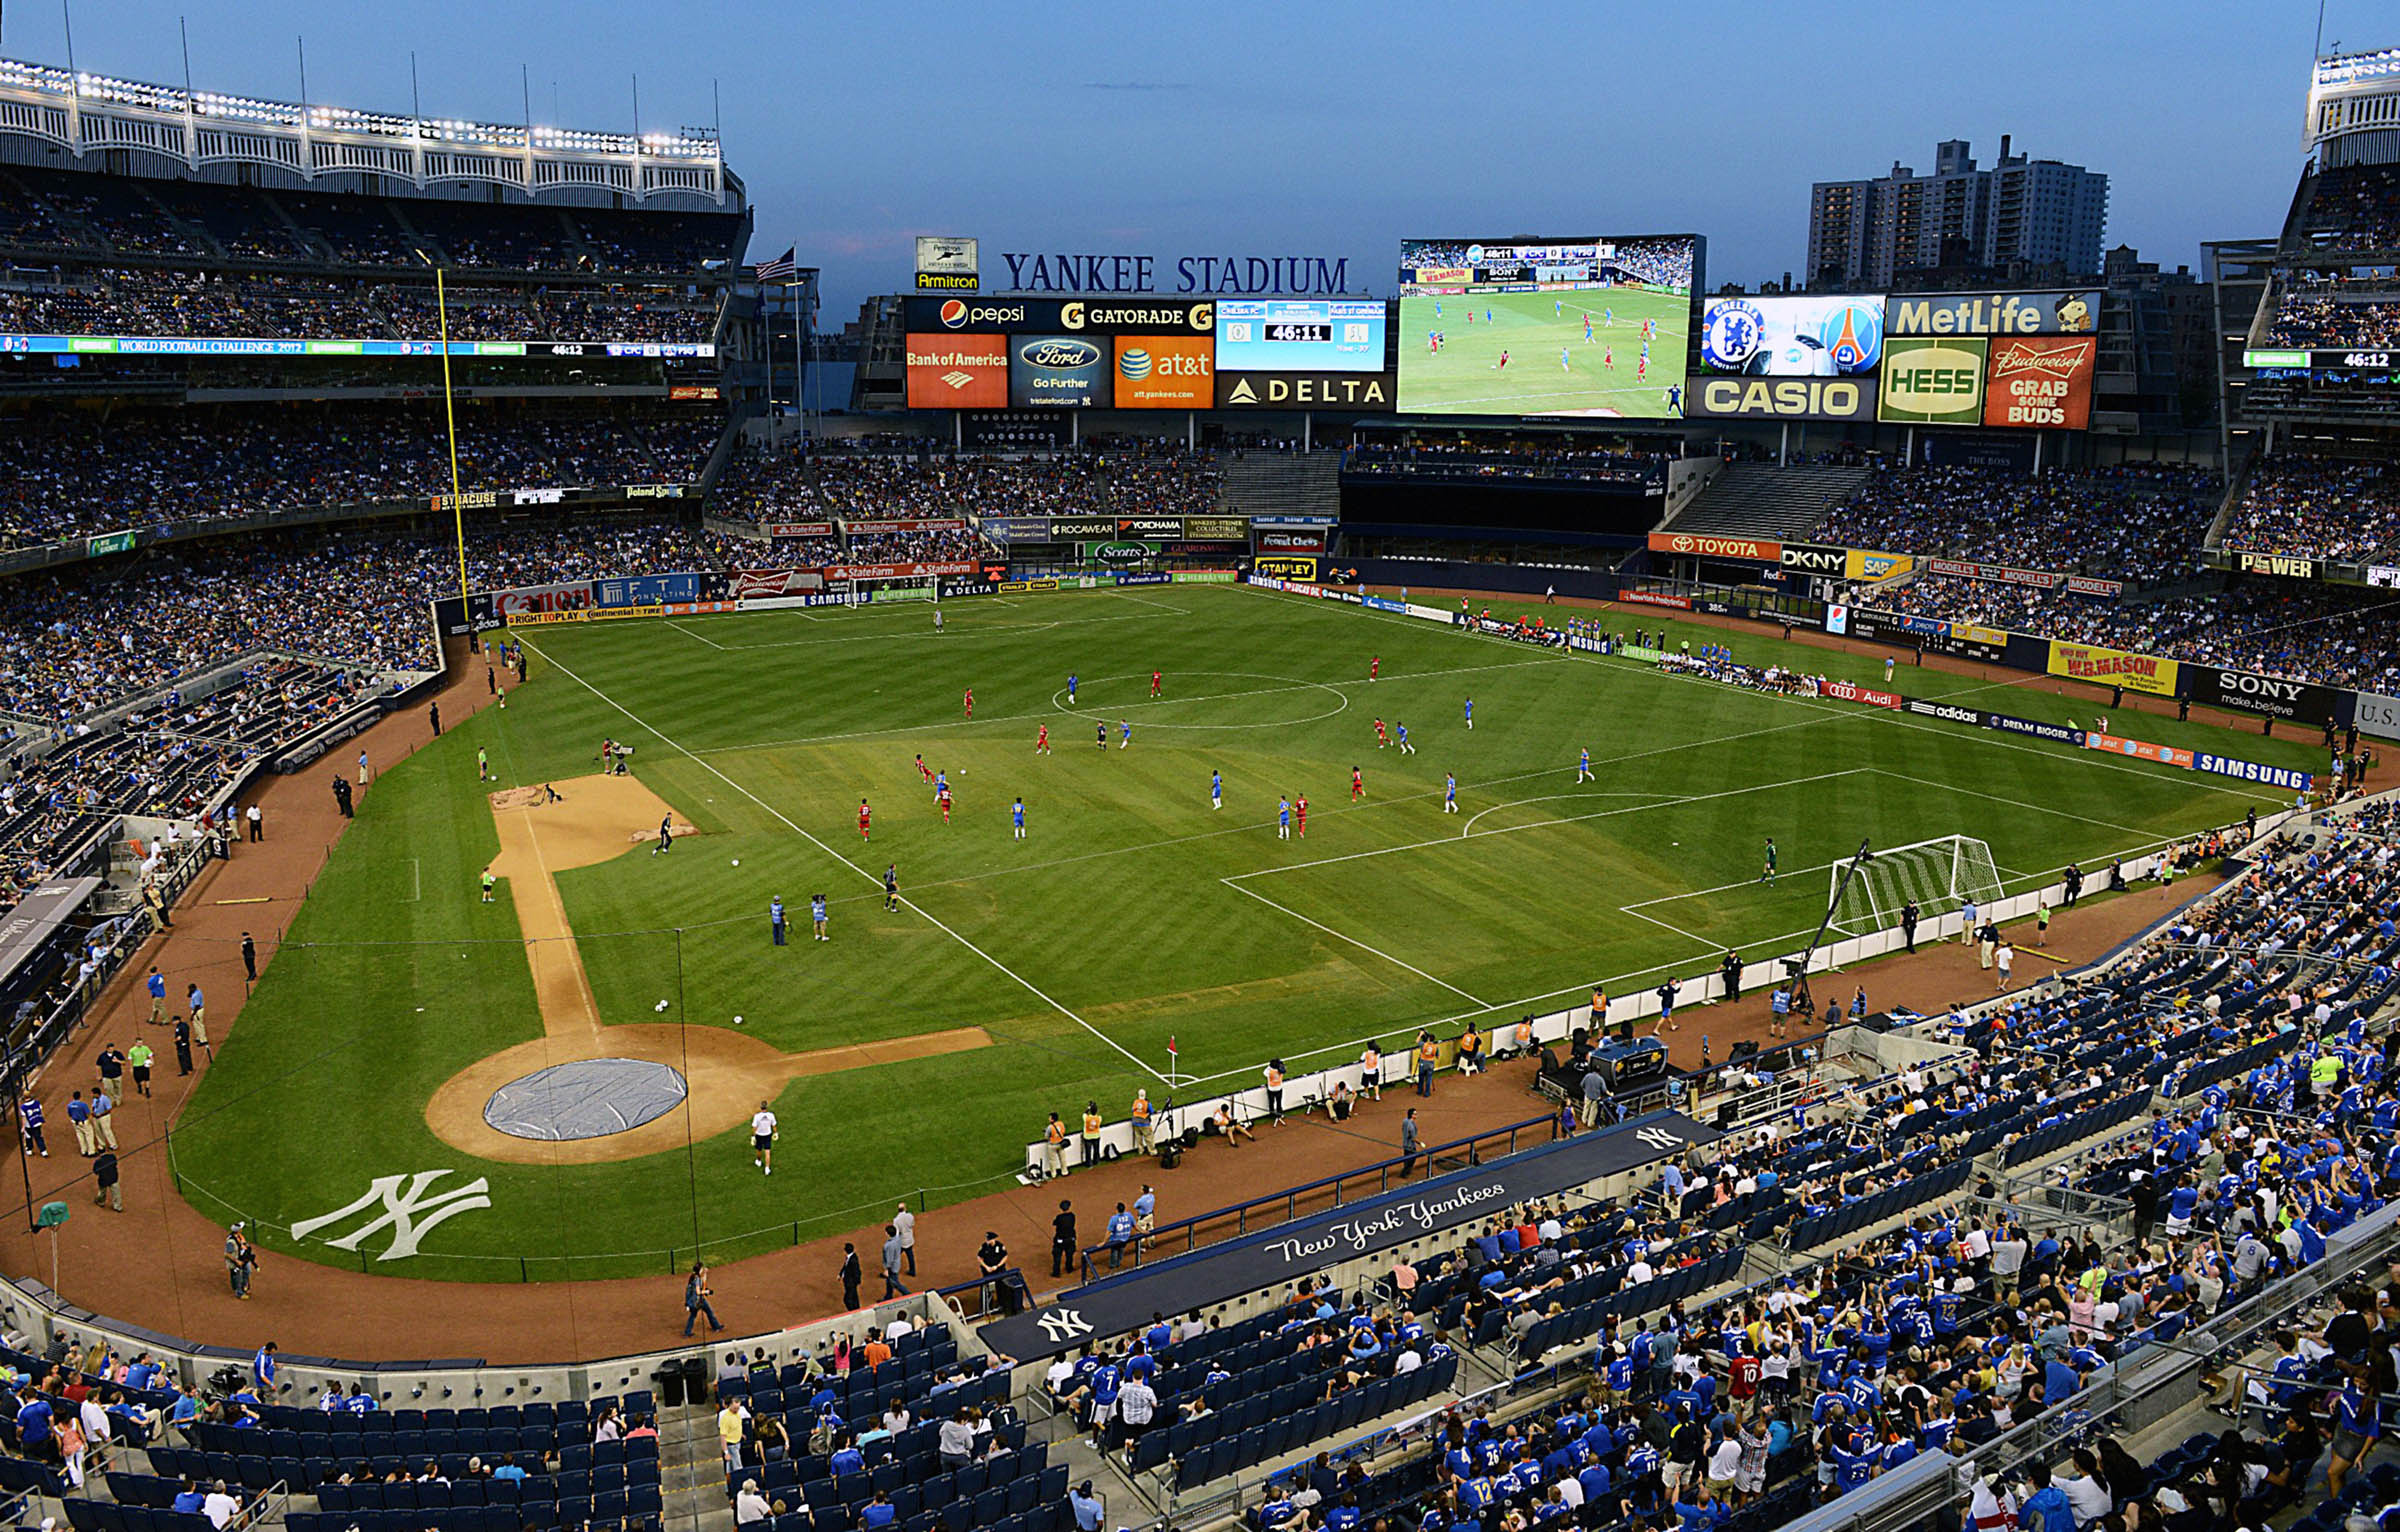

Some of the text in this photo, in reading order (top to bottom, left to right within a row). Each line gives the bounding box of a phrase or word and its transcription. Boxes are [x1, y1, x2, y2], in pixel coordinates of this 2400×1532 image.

[918, 273, 978, 289] Armitron
[1002, 253, 1349, 295] YANKEE STADIUM
[970, 305, 1025, 325] pepsi
[1090, 309, 1184, 325] GATORADE
[1713, 299, 1759, 319] CHELSEA
[1896, 295, 2042, 333] MetLife
[1272, 325, 1323, 341] 46:11
[120, 339, 159, 351] WORLD
[159, 341, 210, 352] FOOTBALL
[211, 342, 274, 353] CHALLENGE
[278, 343, 302, 353] 2012
[552, 344, 584, 356] 46:12
[1036, 342, 1085, 366] Ford
[906, 352, 1008, 367] Bank of America
[1158, 353, 1210, 376] at&t
[1995, 349, 2084, 370] Budweiser
[2344, 353, 2389, 367] 46:12
[1033, 378, 1088, 389] Go Further
[1889, 368, 1975, 395] HESS
[2009, 379, 2069, 398] GRAB
[1268, 379, 1386, 404] DELTA
[1704, 380, 1860, 416] CASIO
[2018, 395, 2057, 407] SOME
[2008, 407, 2065, 425] BUDS
[1968, 456, 1985, 465] THE
[1061, 525, 1113, 534] ROCAWEAR
[1132, 521, 1180, 530] YOKOHAMA
[1263, 536, 1319, 547] Peanut Chews
[1695, 538, 1759, 558] TOYOTA
[1103, 545, 1142, 558] Scotts
[1782, 550, 1846, 571] DKNY
[1864, 558, 1890, 576] SAP
[1933, 560, 1975, 575] MODELL'S
[2241, 554, 2312, 578] PWER
[1261, 564, 1310, 575] STANLEY
[1763, 568, 1787, 581] FedEx
[2004, 570, 2050, 586] MODELL'S
[956, 585, 992, 595] DELTA
[1249, 575, 1282, 589] SAMSUNG
[2070, 579, 2120, 596] MODELL'S
[497, 588, 591, 613] Canon
[809, 591, 869, 606] SAMSUNG
[515, 614, 542, 625] RIGHT
[587, 607, 634, 619] Continental
[1915, 621, 1935, 631] pepsi
[1560, 632, 1608, 654] SMSUNG
[2068, 656, 2158, 678] W.B.MASON
[2219, 672, 2304, 701] SONY
[1863, 691, 1892, 706] Audi
[1936, 705, 1978, 724] adidas
[2003, 718, 2071, 741] DREAM BIGGER.
[2200, 753, 2303, 790] SAMSUNG
[1264, 1183, 1505, 1262] New York Yankees
[1941, 1303, 1957, 1319] 12
[1917, 1320, 1934, 1339] 23
[1743, 1368, 1757, 1383] 10
[1852, 1386, 1867, 1406] 12
[1473, 1482, 1494, 1503] 12
